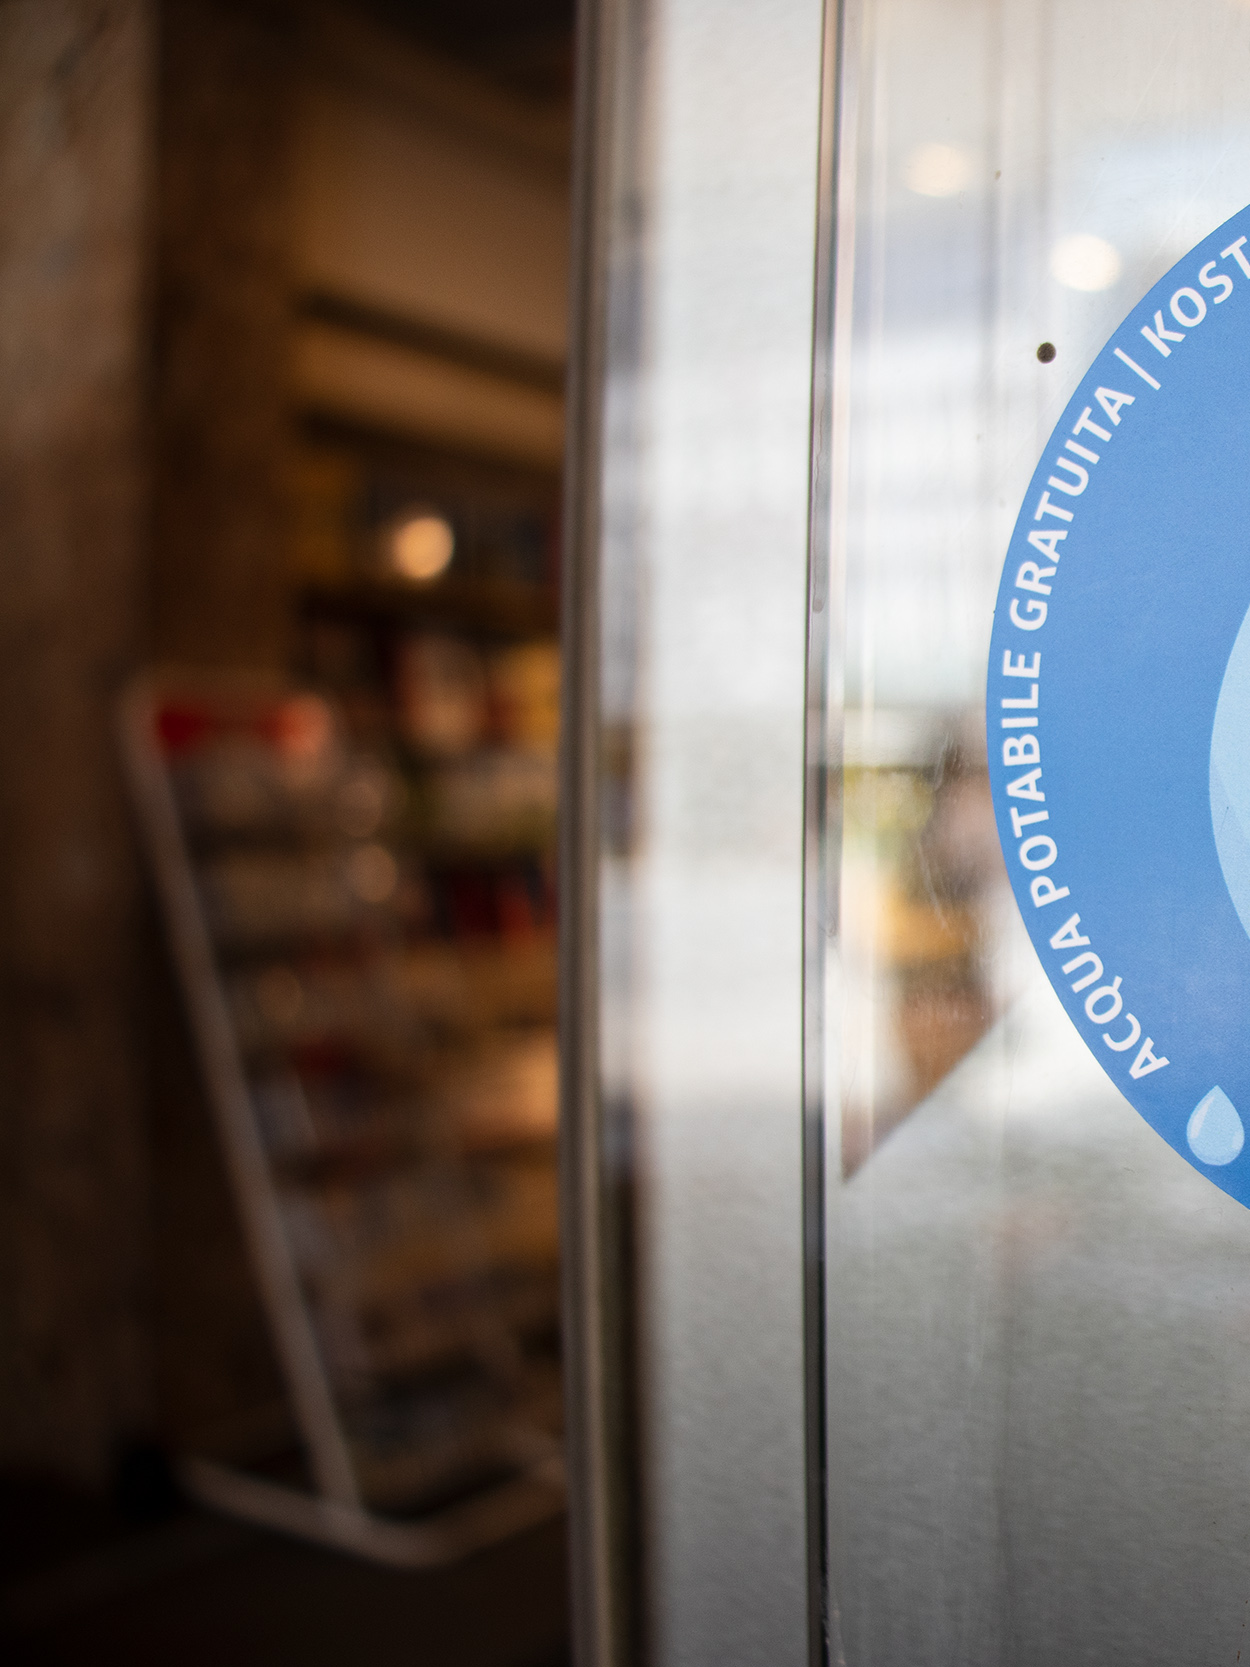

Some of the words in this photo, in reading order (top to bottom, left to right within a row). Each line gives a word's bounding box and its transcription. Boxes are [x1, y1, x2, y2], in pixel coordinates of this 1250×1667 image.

[1010, 386, 1136, 631] GRATUITA
[1001, 649, 1070, 908] POTABILE
[1049, 912, 1170, 1079] ACQUA
